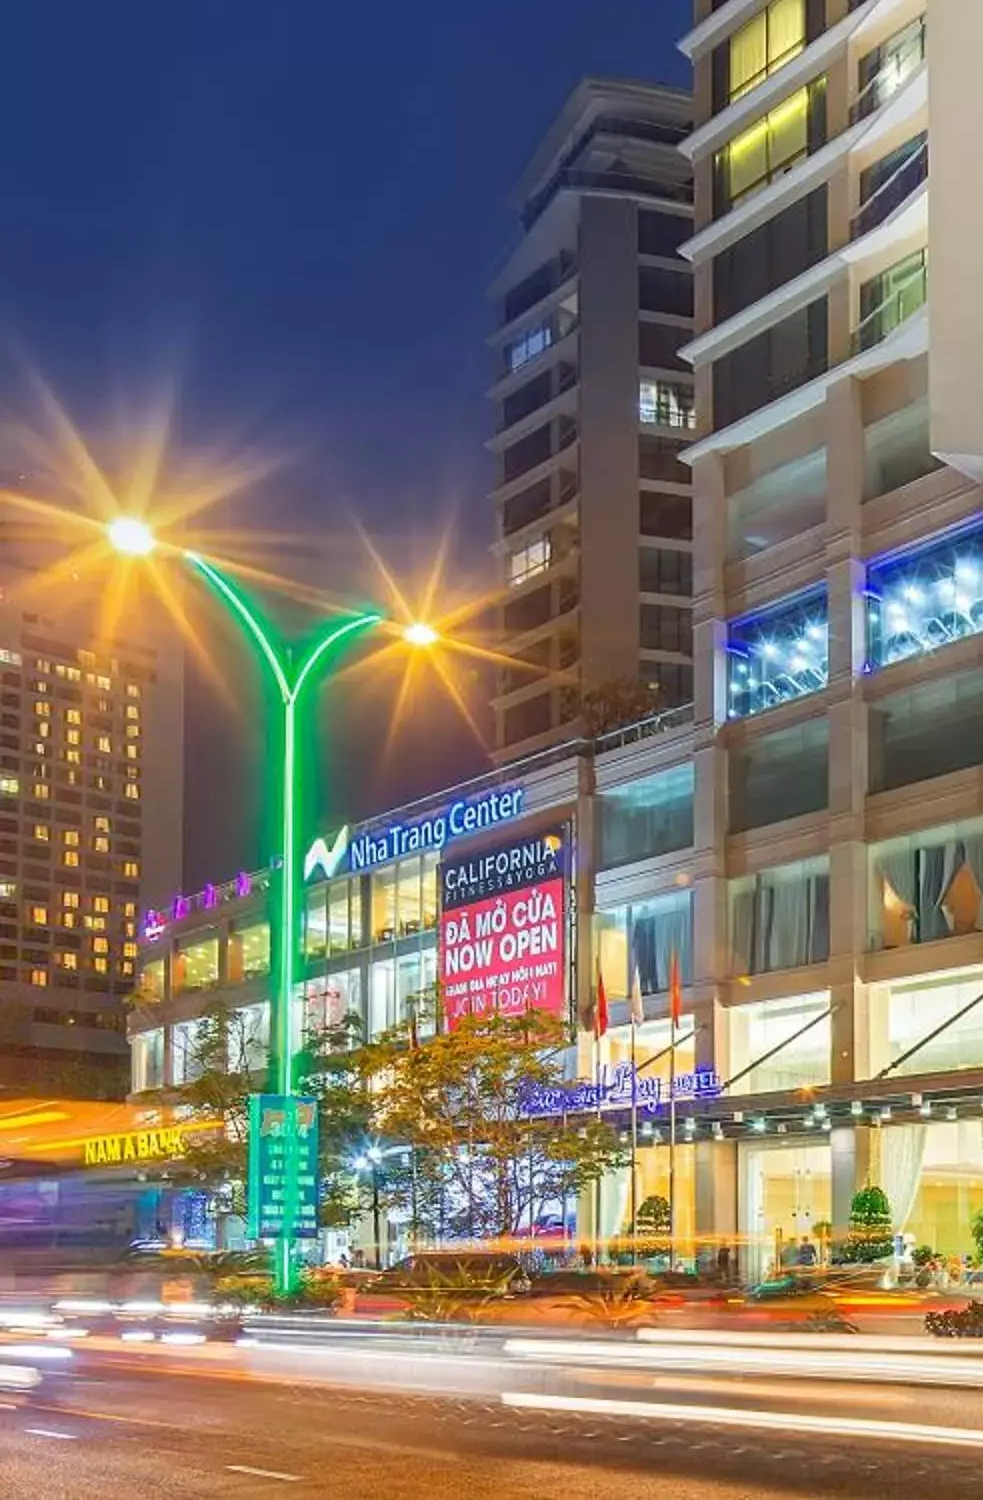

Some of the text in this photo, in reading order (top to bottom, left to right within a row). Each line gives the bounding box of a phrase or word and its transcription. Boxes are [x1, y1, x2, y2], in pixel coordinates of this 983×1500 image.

[351, 788, 526, 870] Nha Trang Center
[444, 840, 557, 889] CALIFORNIA
[445, 921, 557, 976] NOW OPEN
[85, 1137, 121, 1165] NAM
